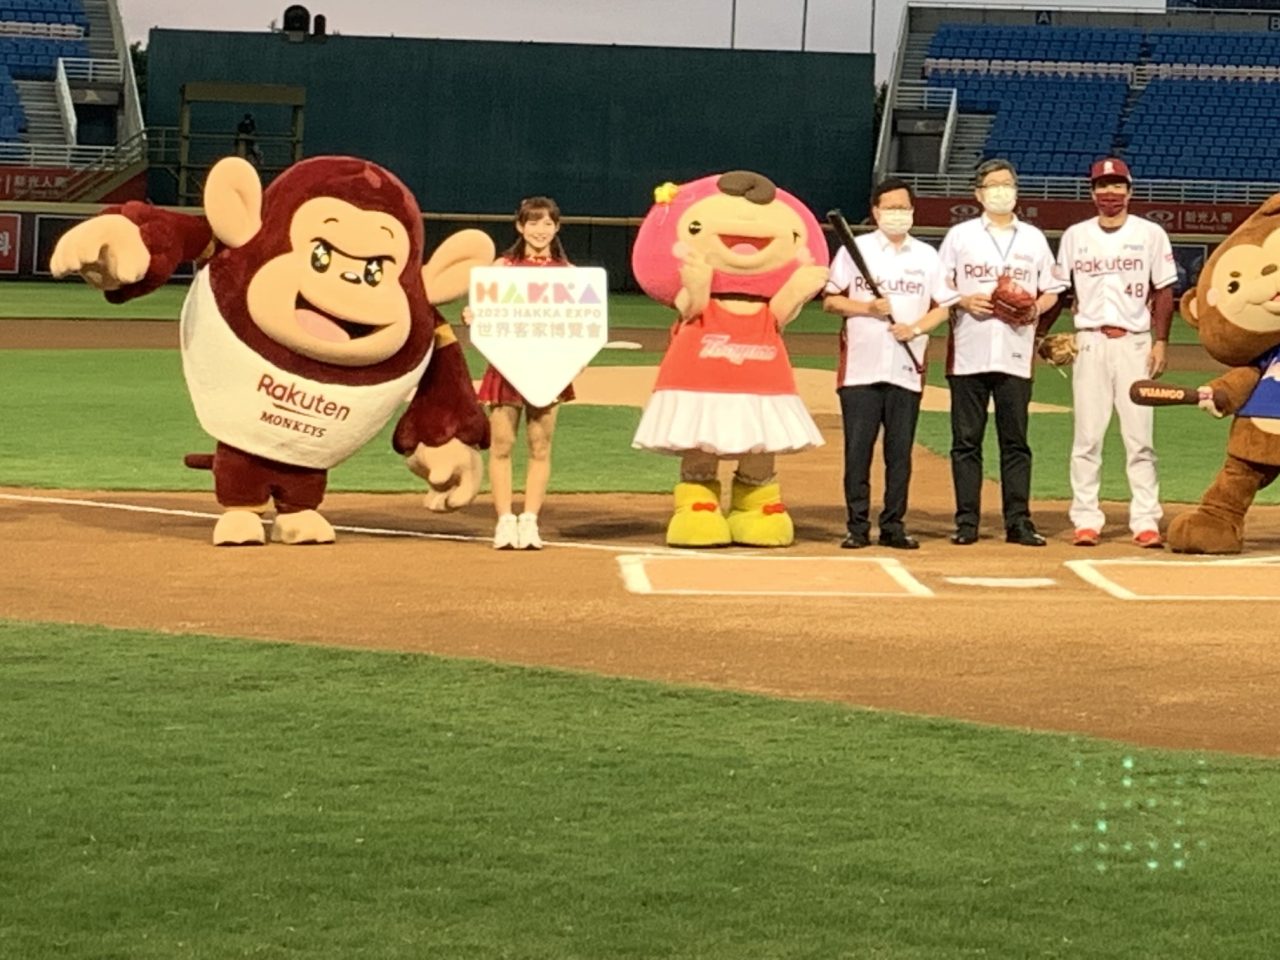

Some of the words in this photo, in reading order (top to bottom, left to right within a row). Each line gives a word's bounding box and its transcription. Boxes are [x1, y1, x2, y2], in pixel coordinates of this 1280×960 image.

[1038, 12, 1050, 24] A
[964, 263, 1032, 283] Rakuten
[1074, 257, 1144, 274] Rakuten
[1124, 283, 1144, 298] 48
[477, 308, 509, 319] 2023
[513, 308, 562, 319] HAKKA
[565, 308, 602, 319] EXPO
[257, 373, 351, 421] Rakuten
[260, 411, 327, 438] MONKEYS
